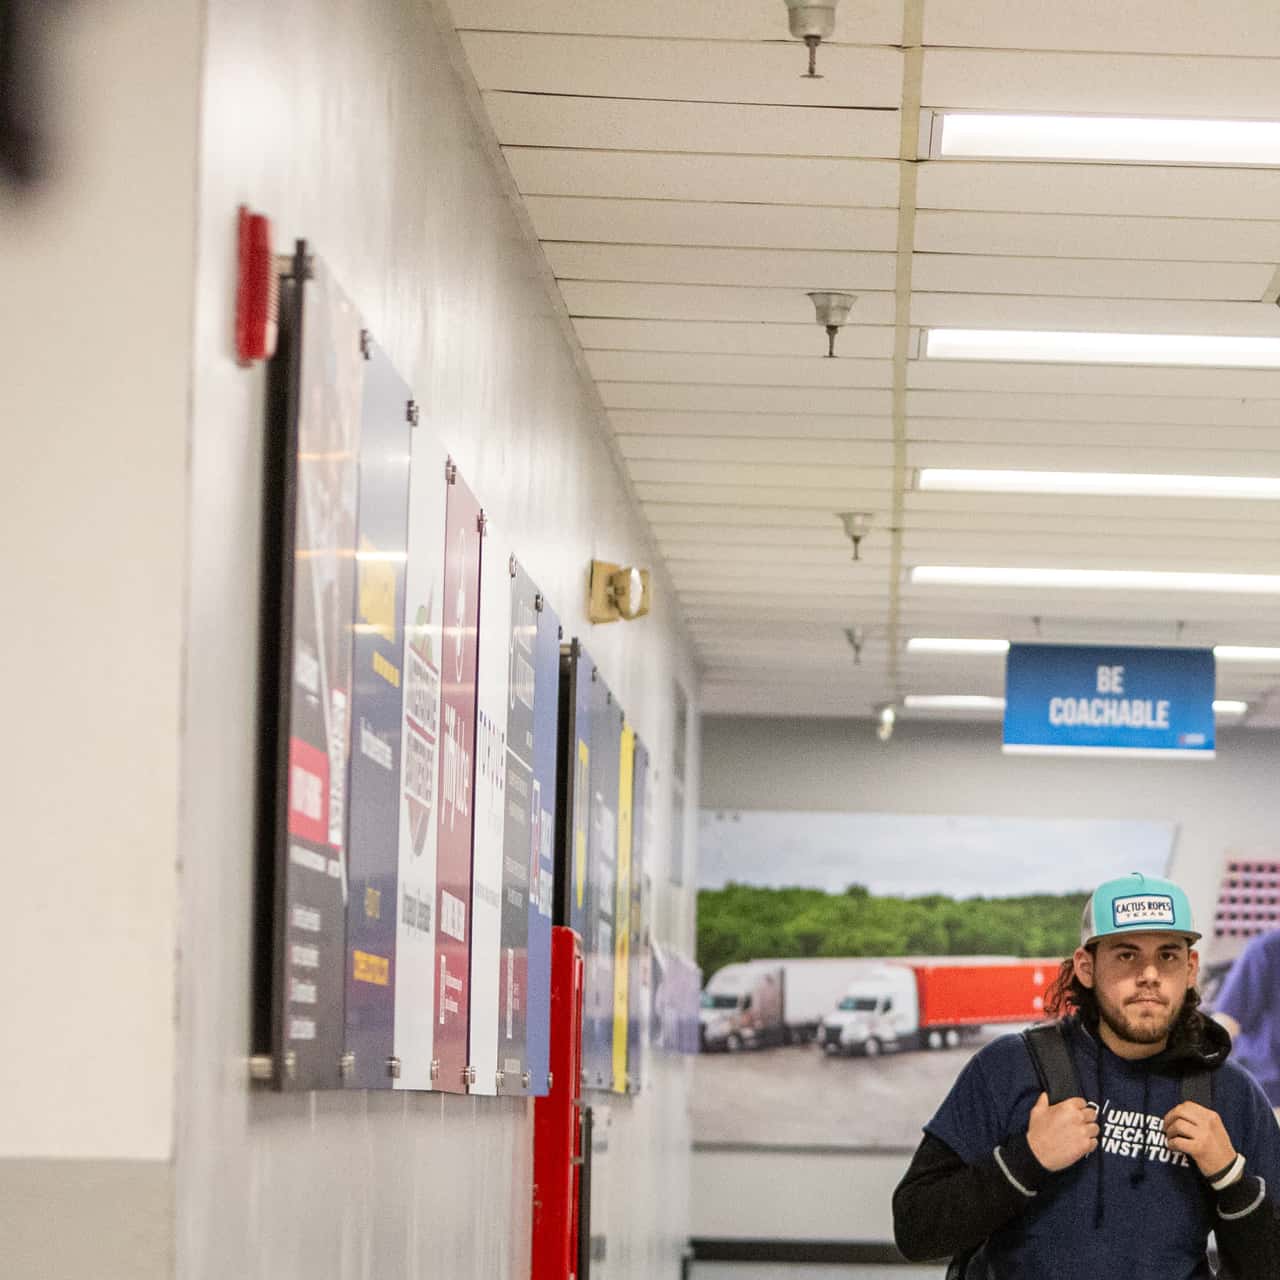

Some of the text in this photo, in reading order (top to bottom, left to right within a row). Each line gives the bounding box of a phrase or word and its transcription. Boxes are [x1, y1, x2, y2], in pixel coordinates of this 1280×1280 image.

[1096, 665, 1125, 694] BE
[1049, 697, 1170, 729] COACHABLE
[1116, 901, 1171, 914] CACTUS ROPES
[1107, 1109, 1165, 1131] UNIVE
